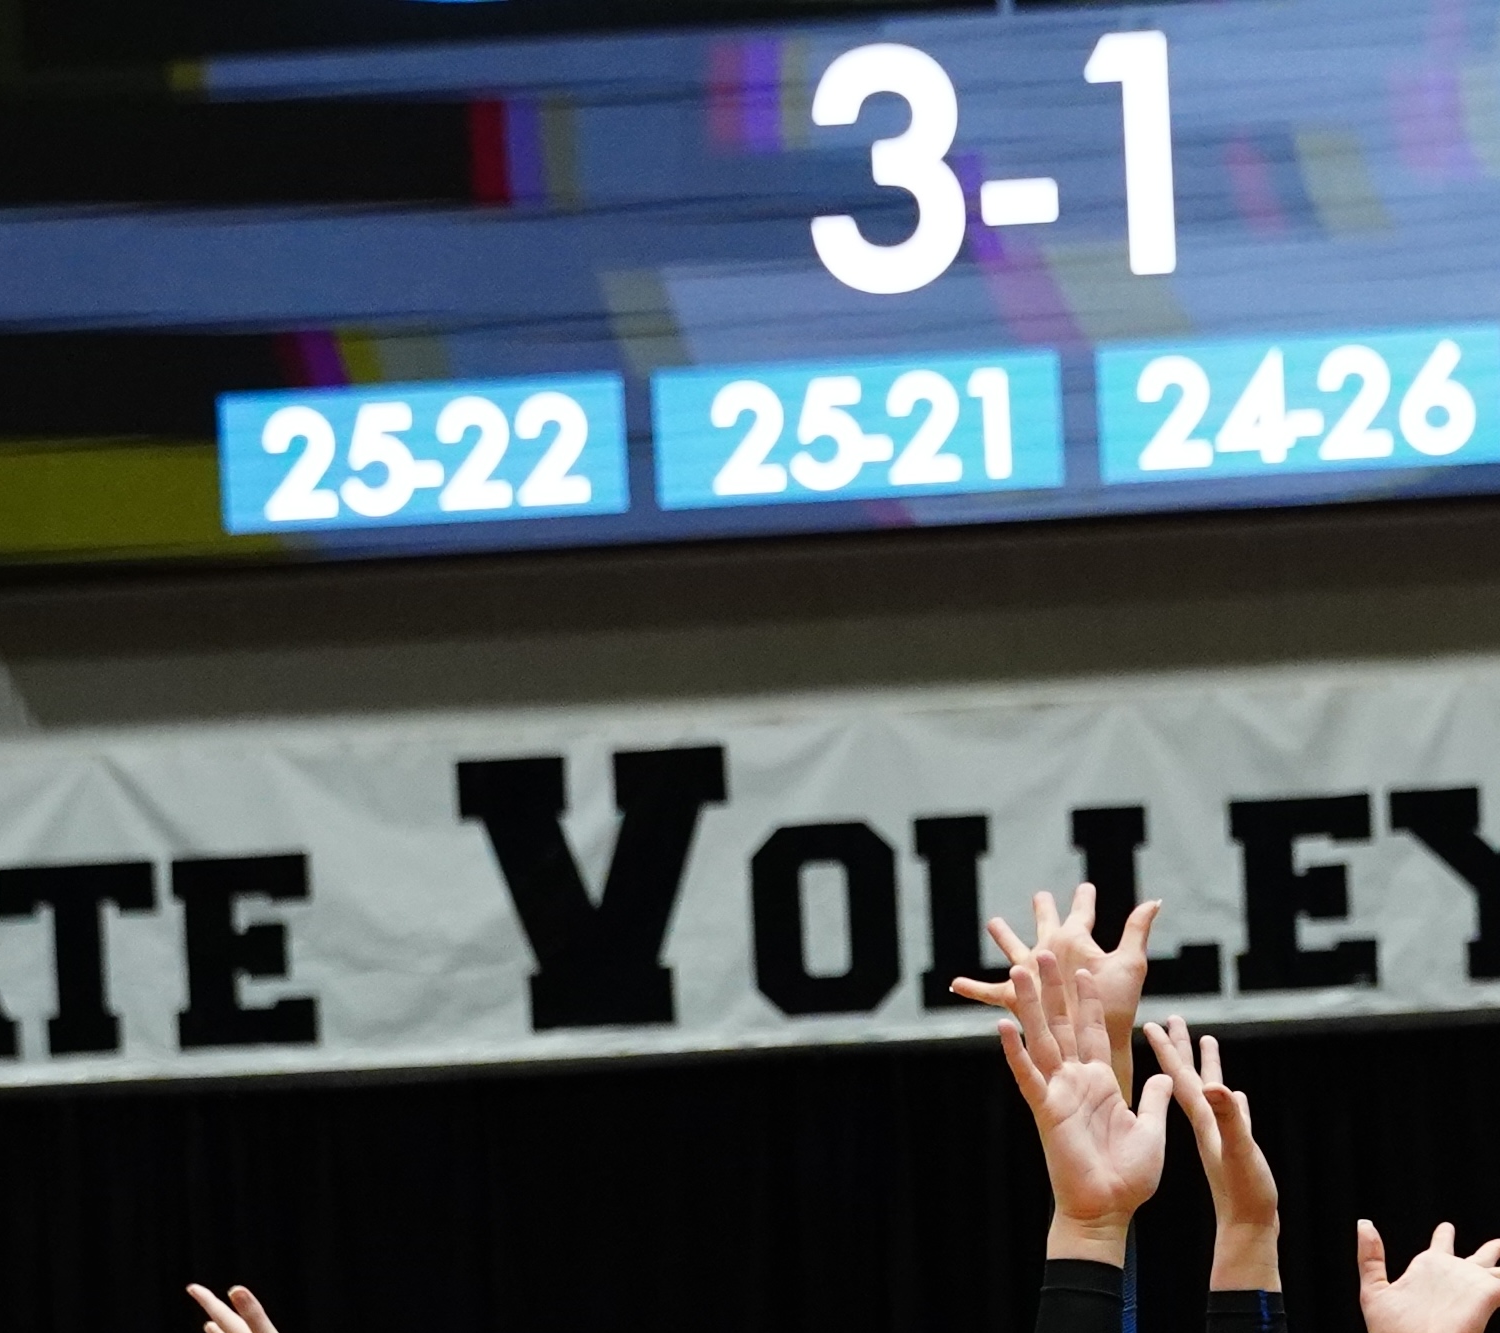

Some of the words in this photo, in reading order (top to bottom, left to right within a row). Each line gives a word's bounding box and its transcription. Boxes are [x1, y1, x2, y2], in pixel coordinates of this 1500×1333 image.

[811, 30, 1178, 294] 3-1
[261, 391, 593, 522] 25-22
[710, 366, 1014, 496] 25-21
[1136, 338, 1477, 471] 24-26
